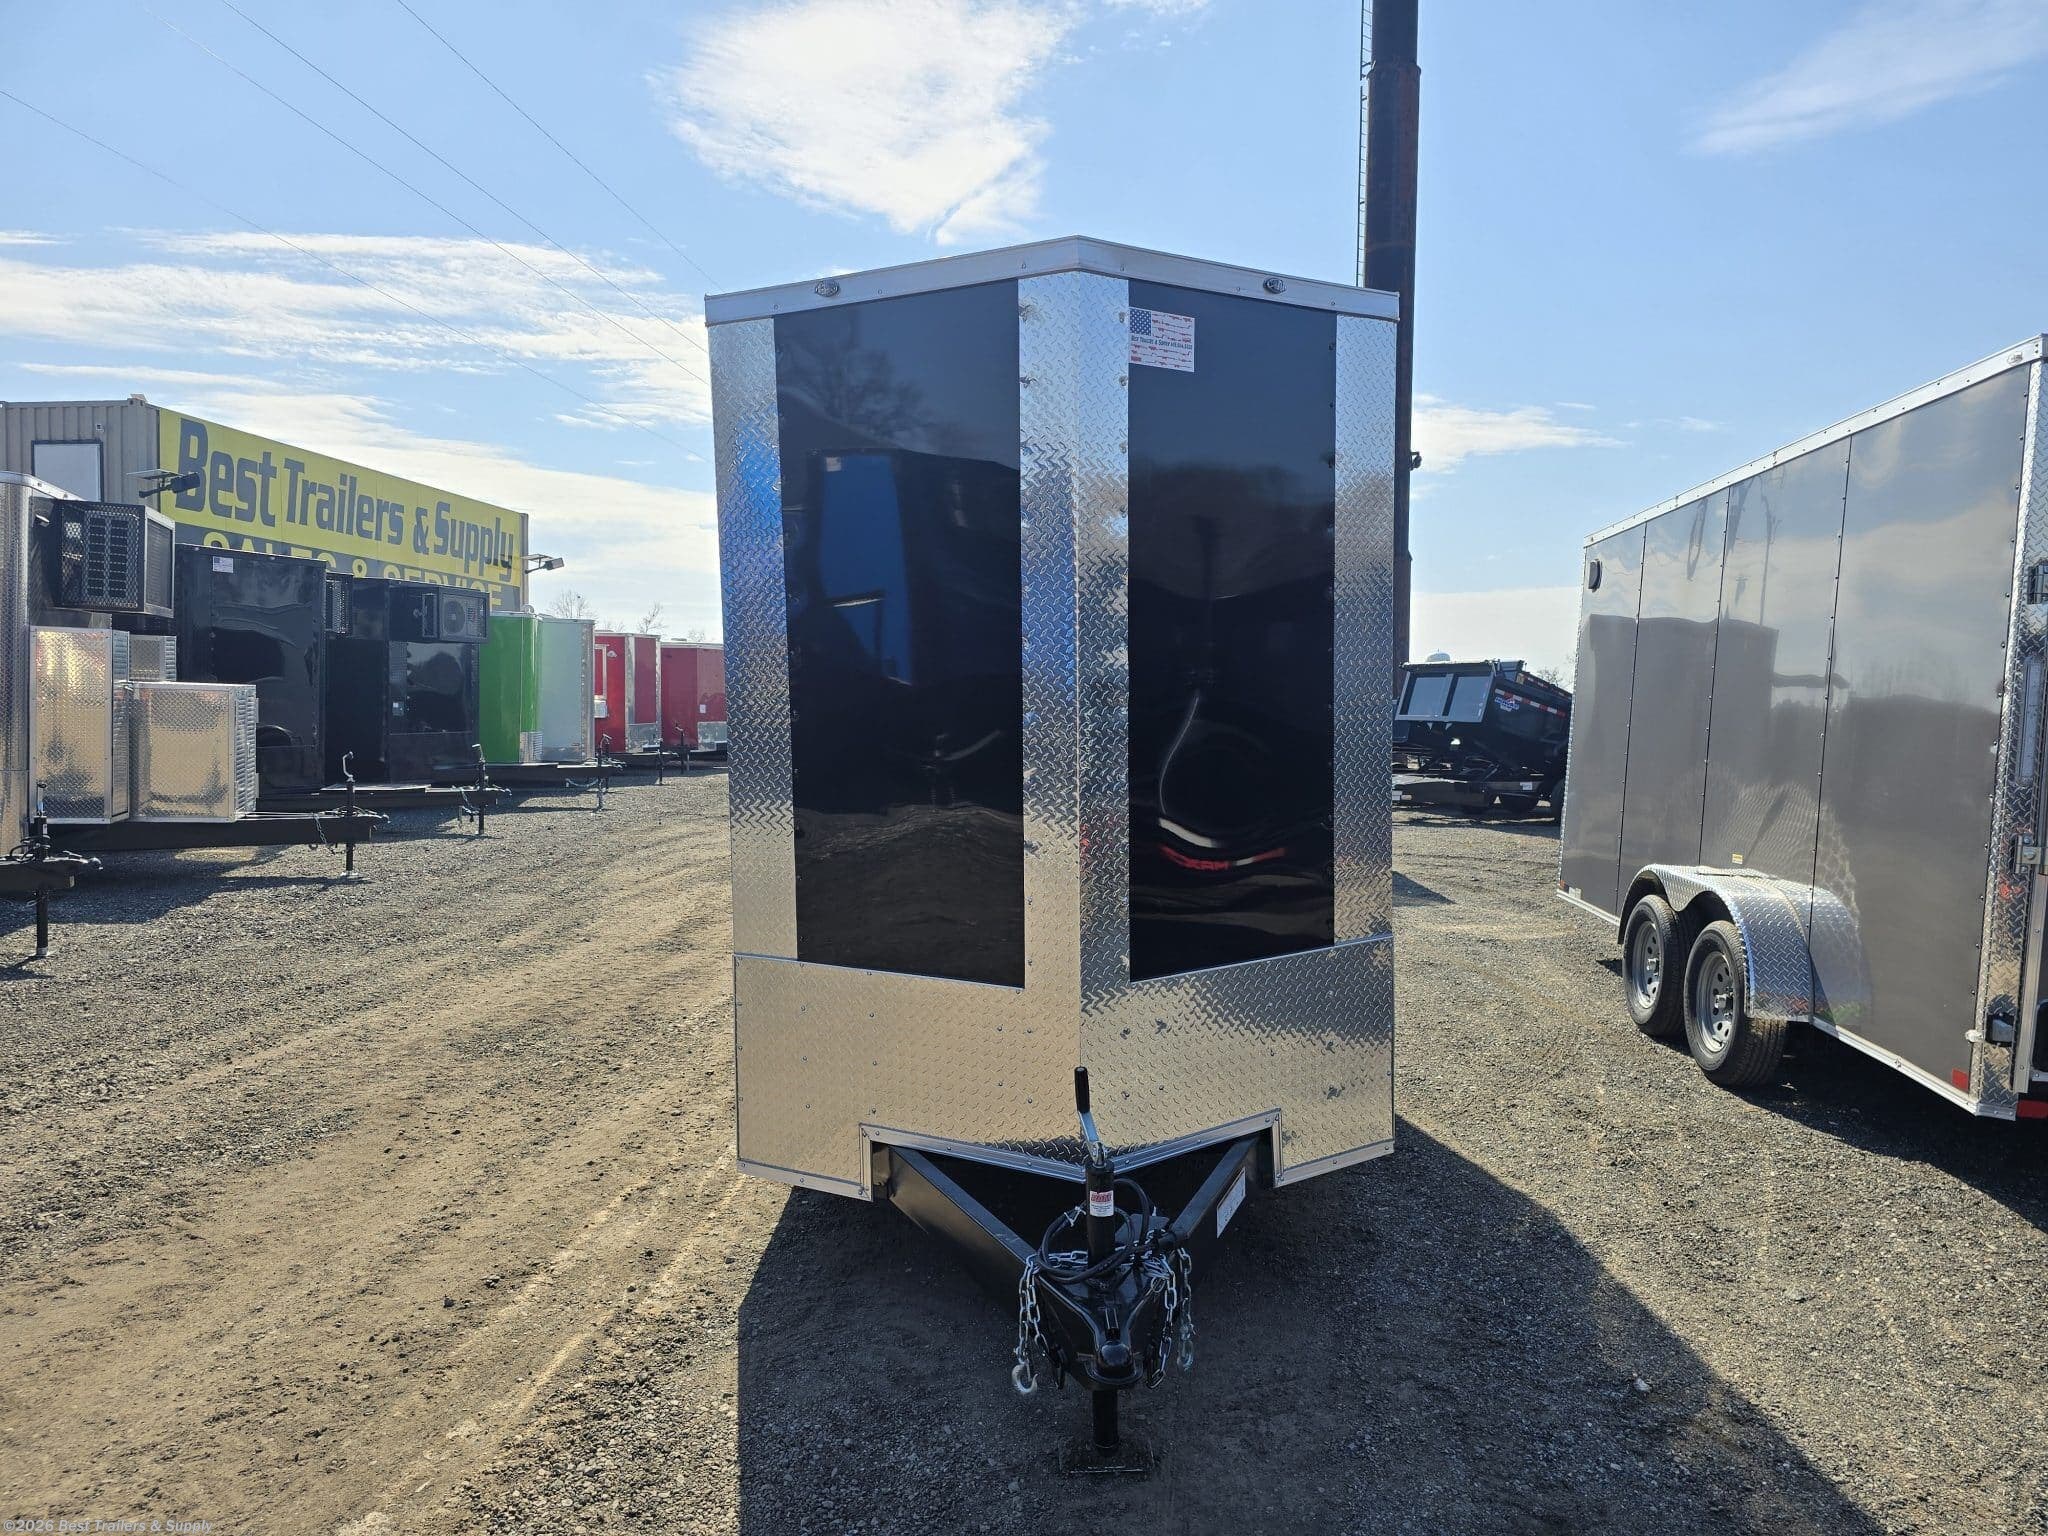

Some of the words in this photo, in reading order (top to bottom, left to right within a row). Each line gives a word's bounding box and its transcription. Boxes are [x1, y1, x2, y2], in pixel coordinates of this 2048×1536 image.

[175, 417, 277, 527] Best
[284, 458, 405, 546] Trailers
[413, 506, 430, 556] &
[434, 500, 514, 583] Supply
